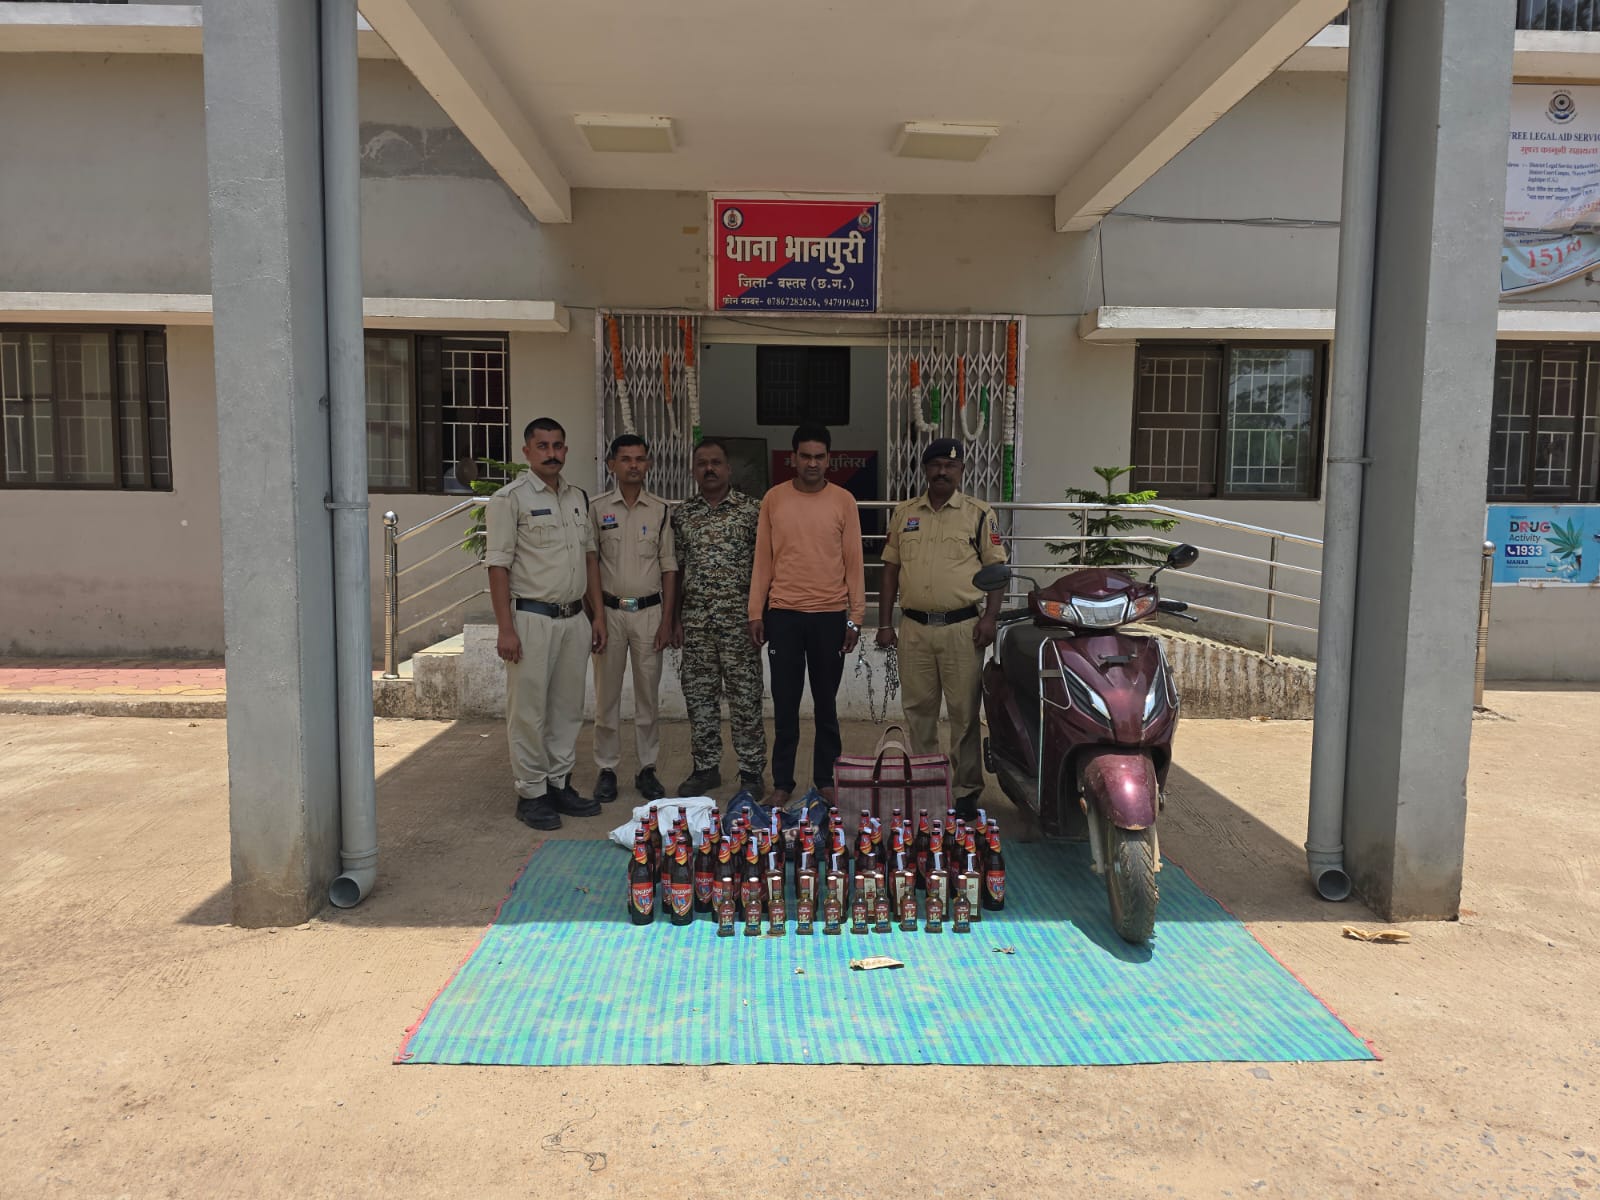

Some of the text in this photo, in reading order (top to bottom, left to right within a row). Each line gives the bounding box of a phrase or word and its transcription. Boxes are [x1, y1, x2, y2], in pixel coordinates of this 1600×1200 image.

[1530, 132, 1556, 141] LEGAL
[1558, 132, 1572, 141] AID
[726, 230, 866, 275] थाना भानपुरी
[830, 454, 866, 471] पुलिस
[1510, 521, 1551, 533] DRUG
[1509, 534, 1541, 543] Activity
[1515, 545, 1543, 556] 1933
